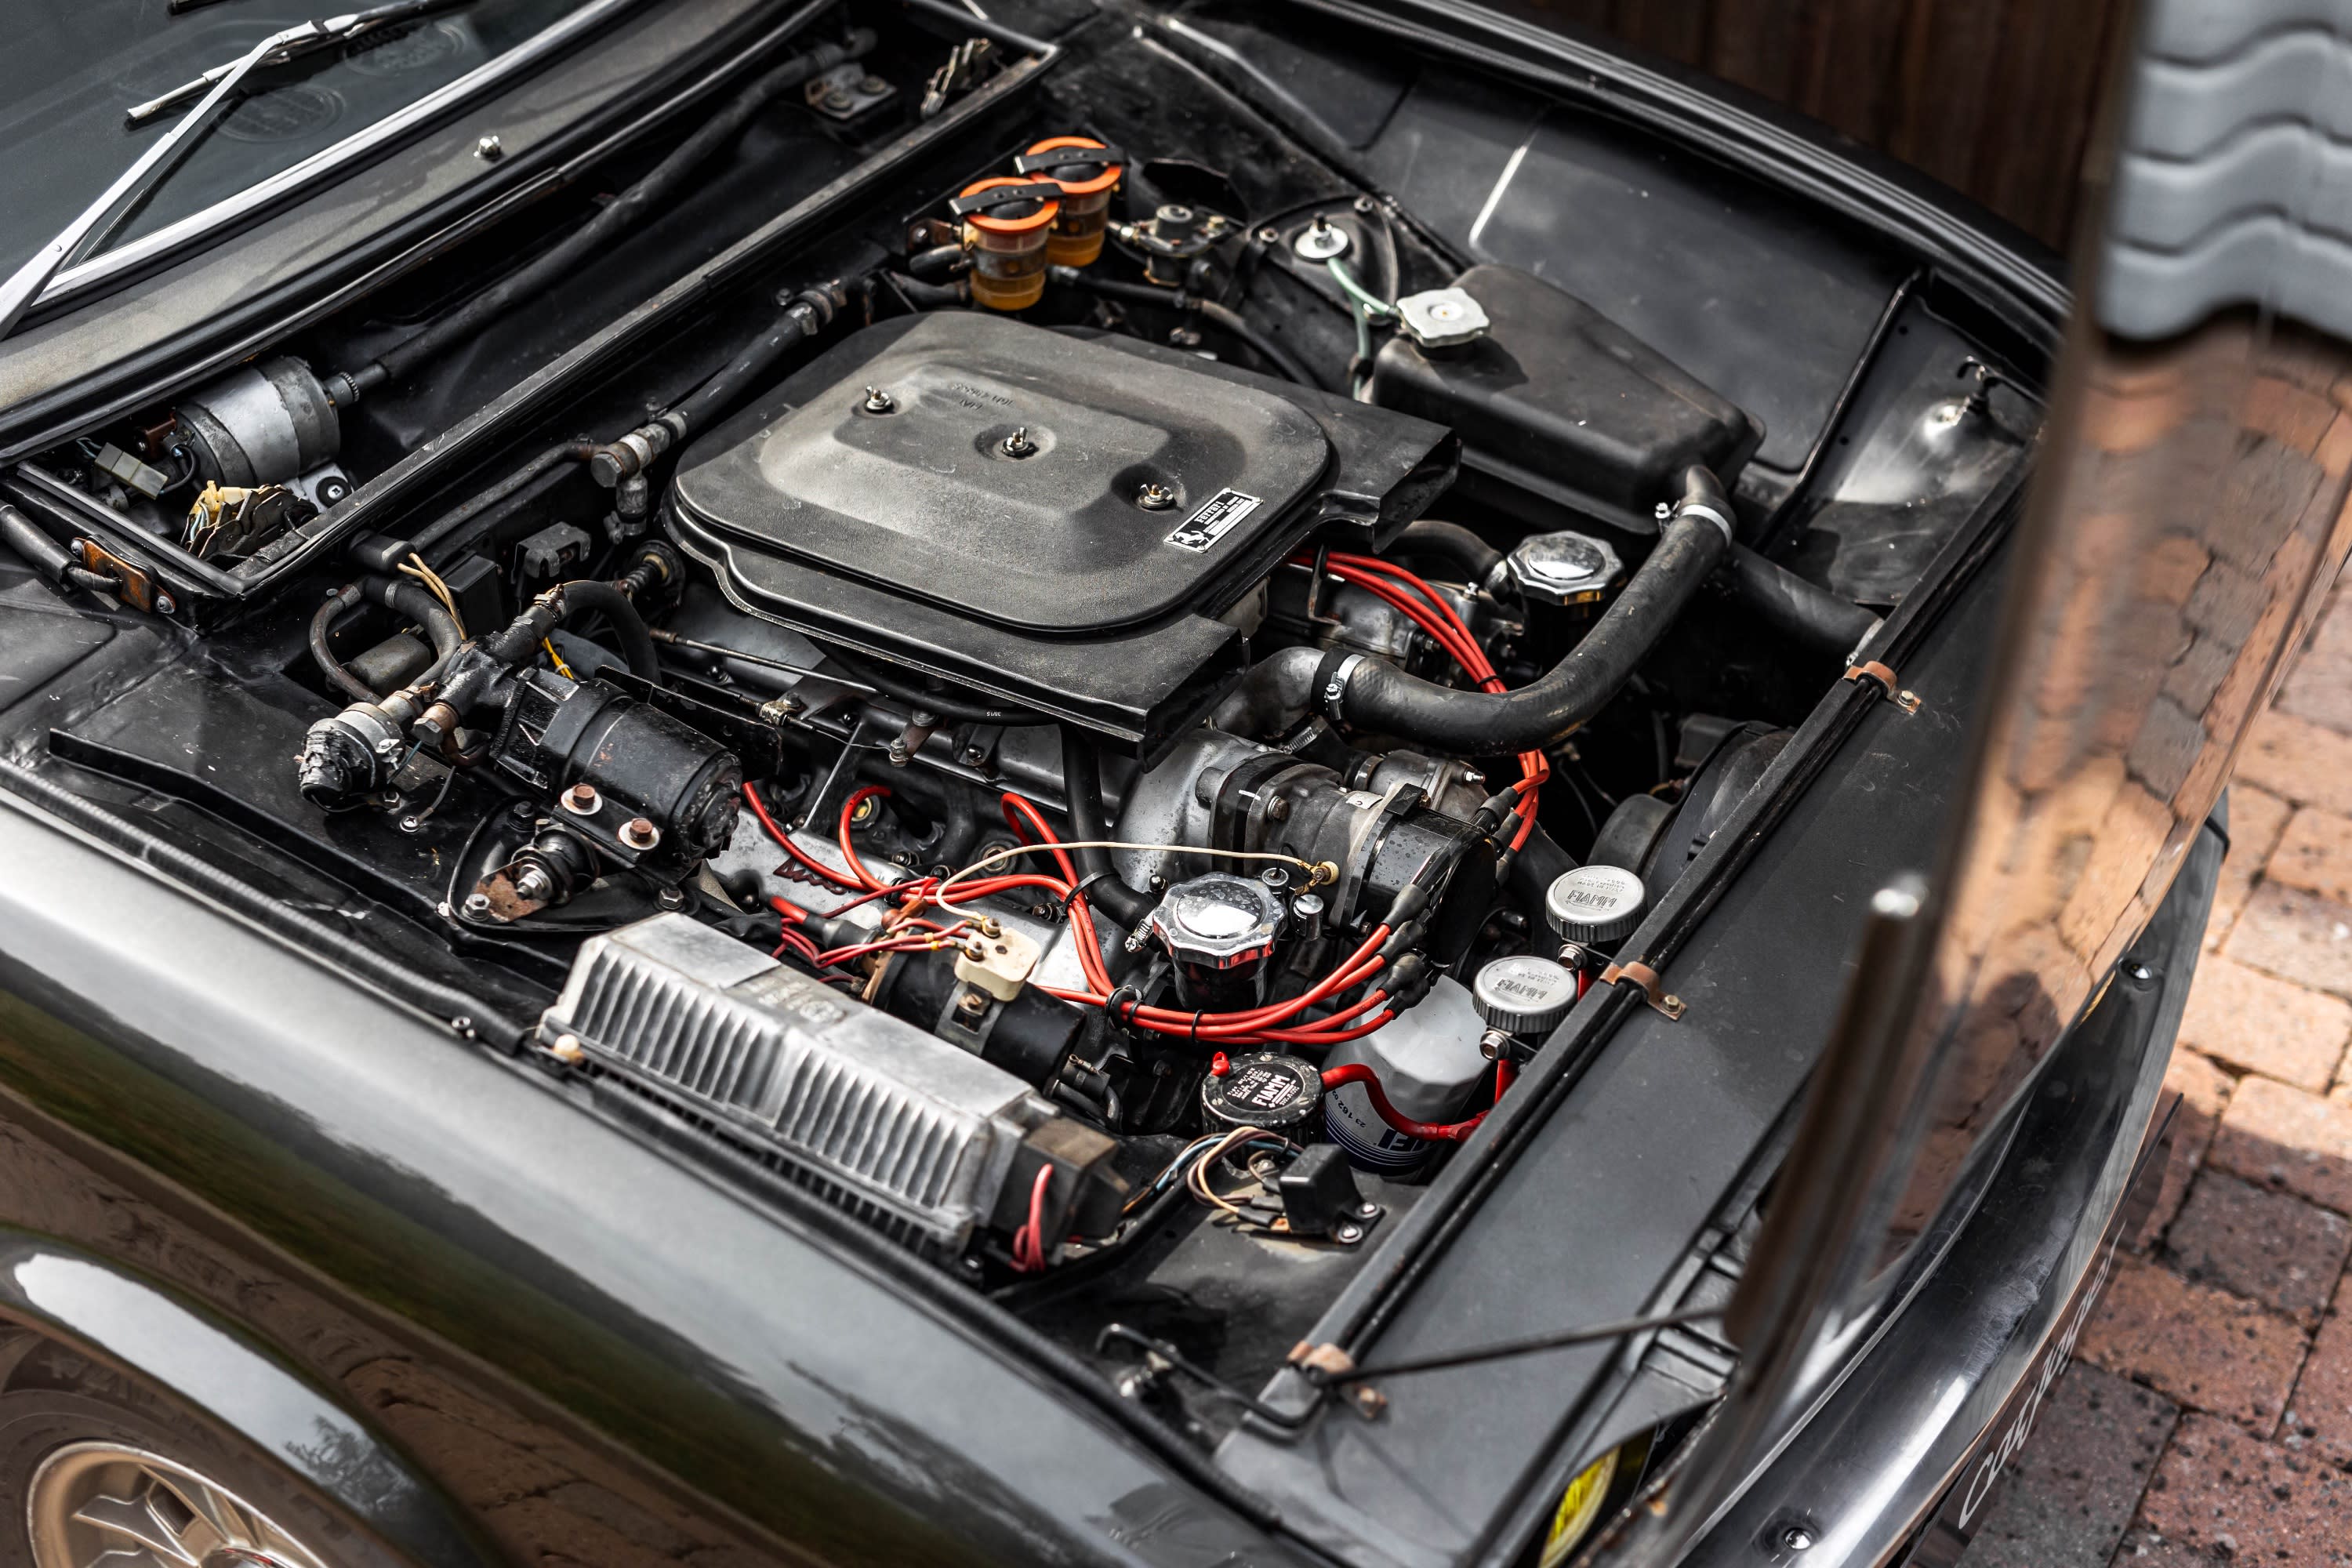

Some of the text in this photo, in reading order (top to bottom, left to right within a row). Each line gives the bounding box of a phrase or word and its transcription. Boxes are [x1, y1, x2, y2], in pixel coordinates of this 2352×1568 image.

[1194, 501, 1225, 523] Ferrari
[1567, 890, 1617, 908] FIAMM
[1496, 978, 1548, 1000] FIAMM
[1251, 1074, 1290, 1106] FIAMM
[1338, 1100, 1353, 1119] 162
